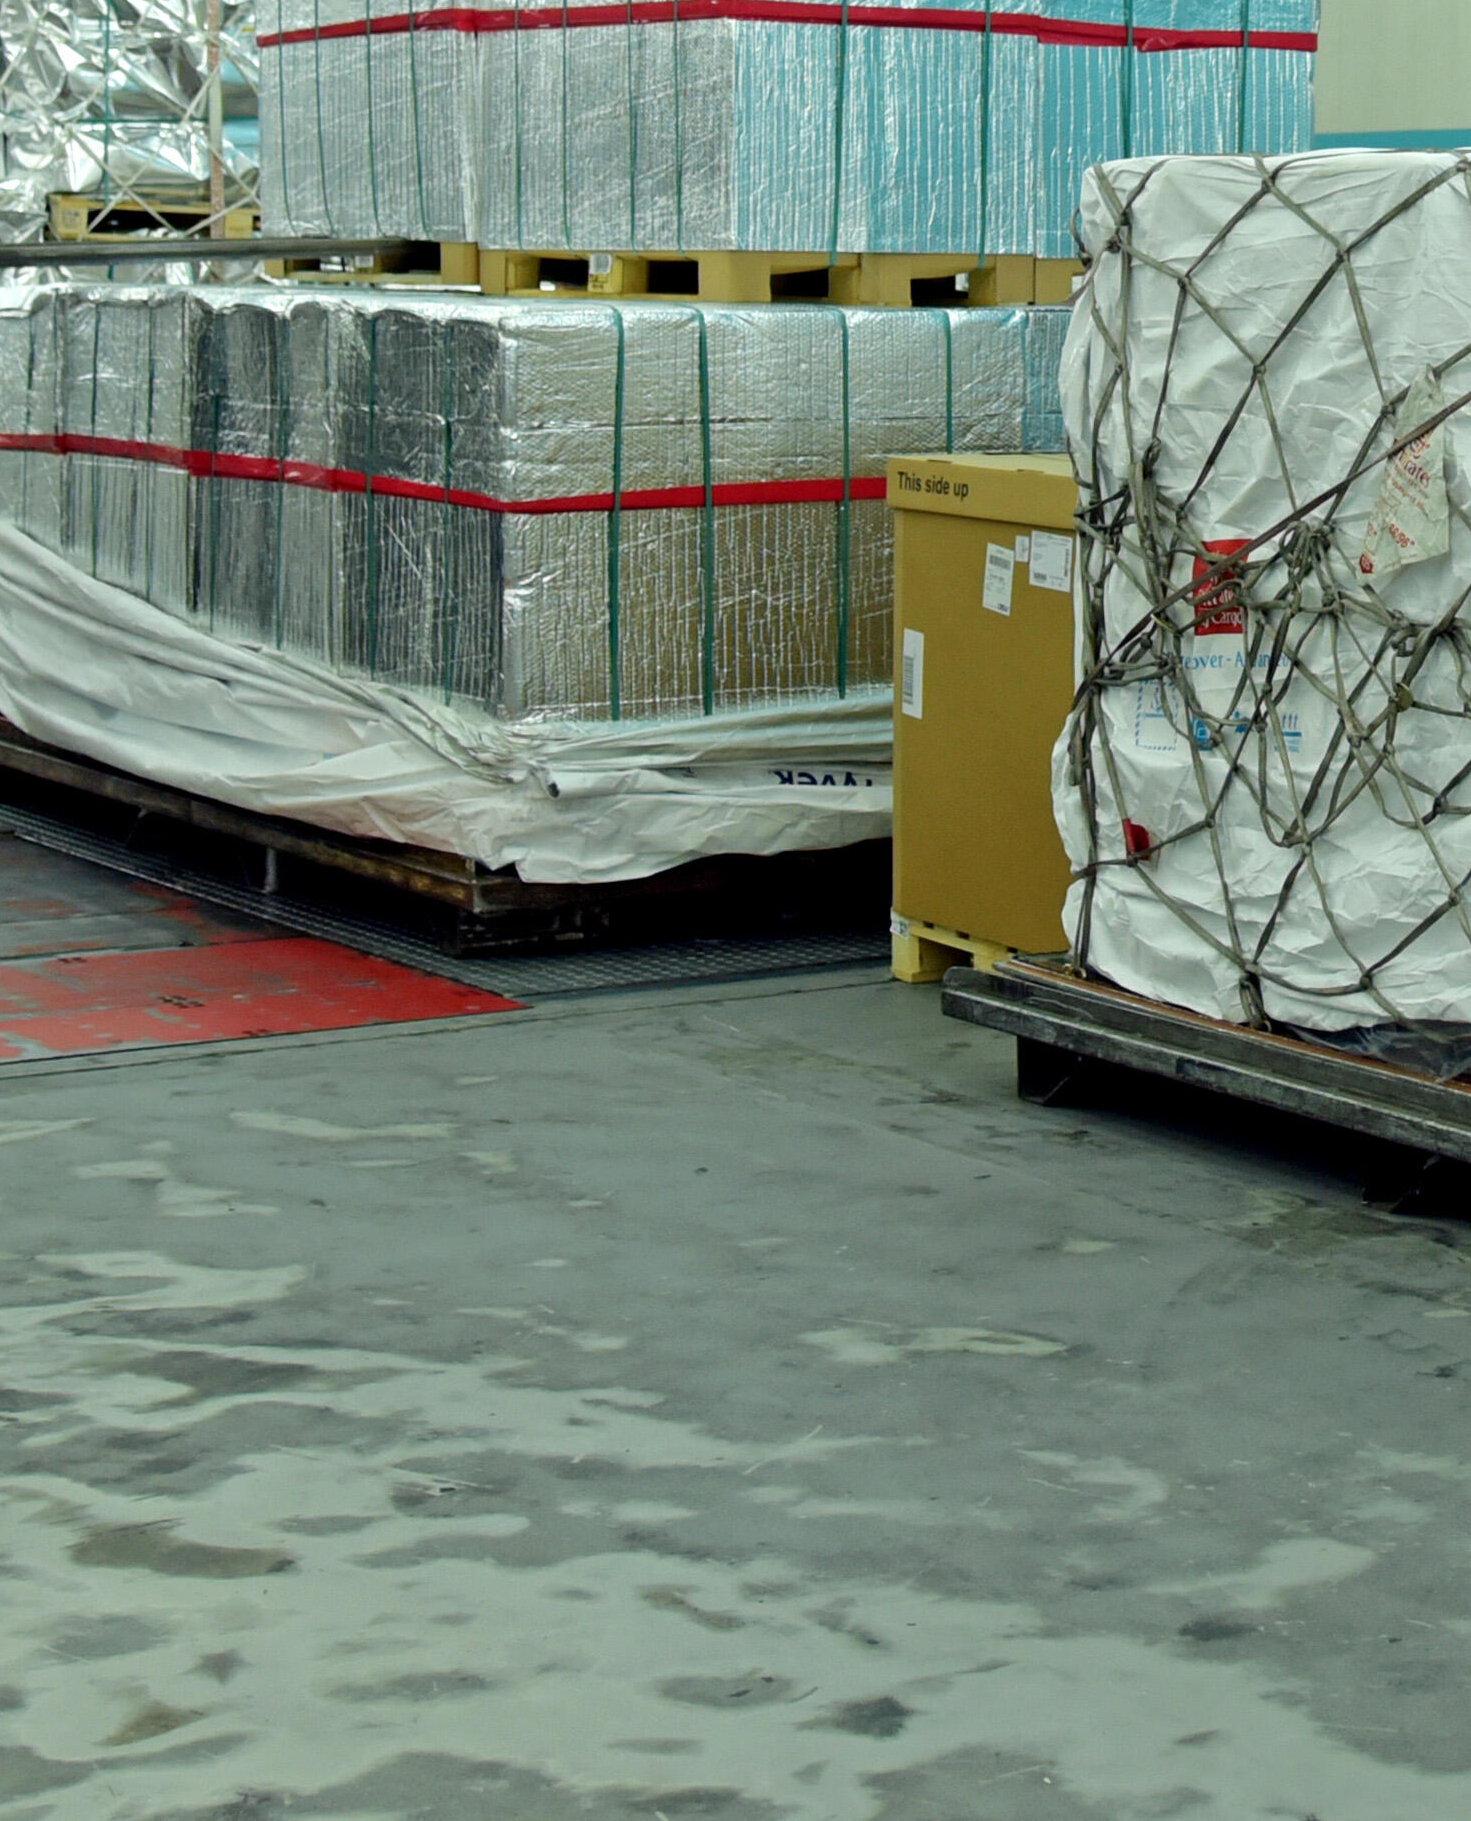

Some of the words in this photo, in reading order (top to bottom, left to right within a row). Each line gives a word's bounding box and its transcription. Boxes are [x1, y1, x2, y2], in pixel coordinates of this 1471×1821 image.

[897, 471, 922, 492] This
[924, 477, 950, 495] side
[953, 482, 970, 501] up
